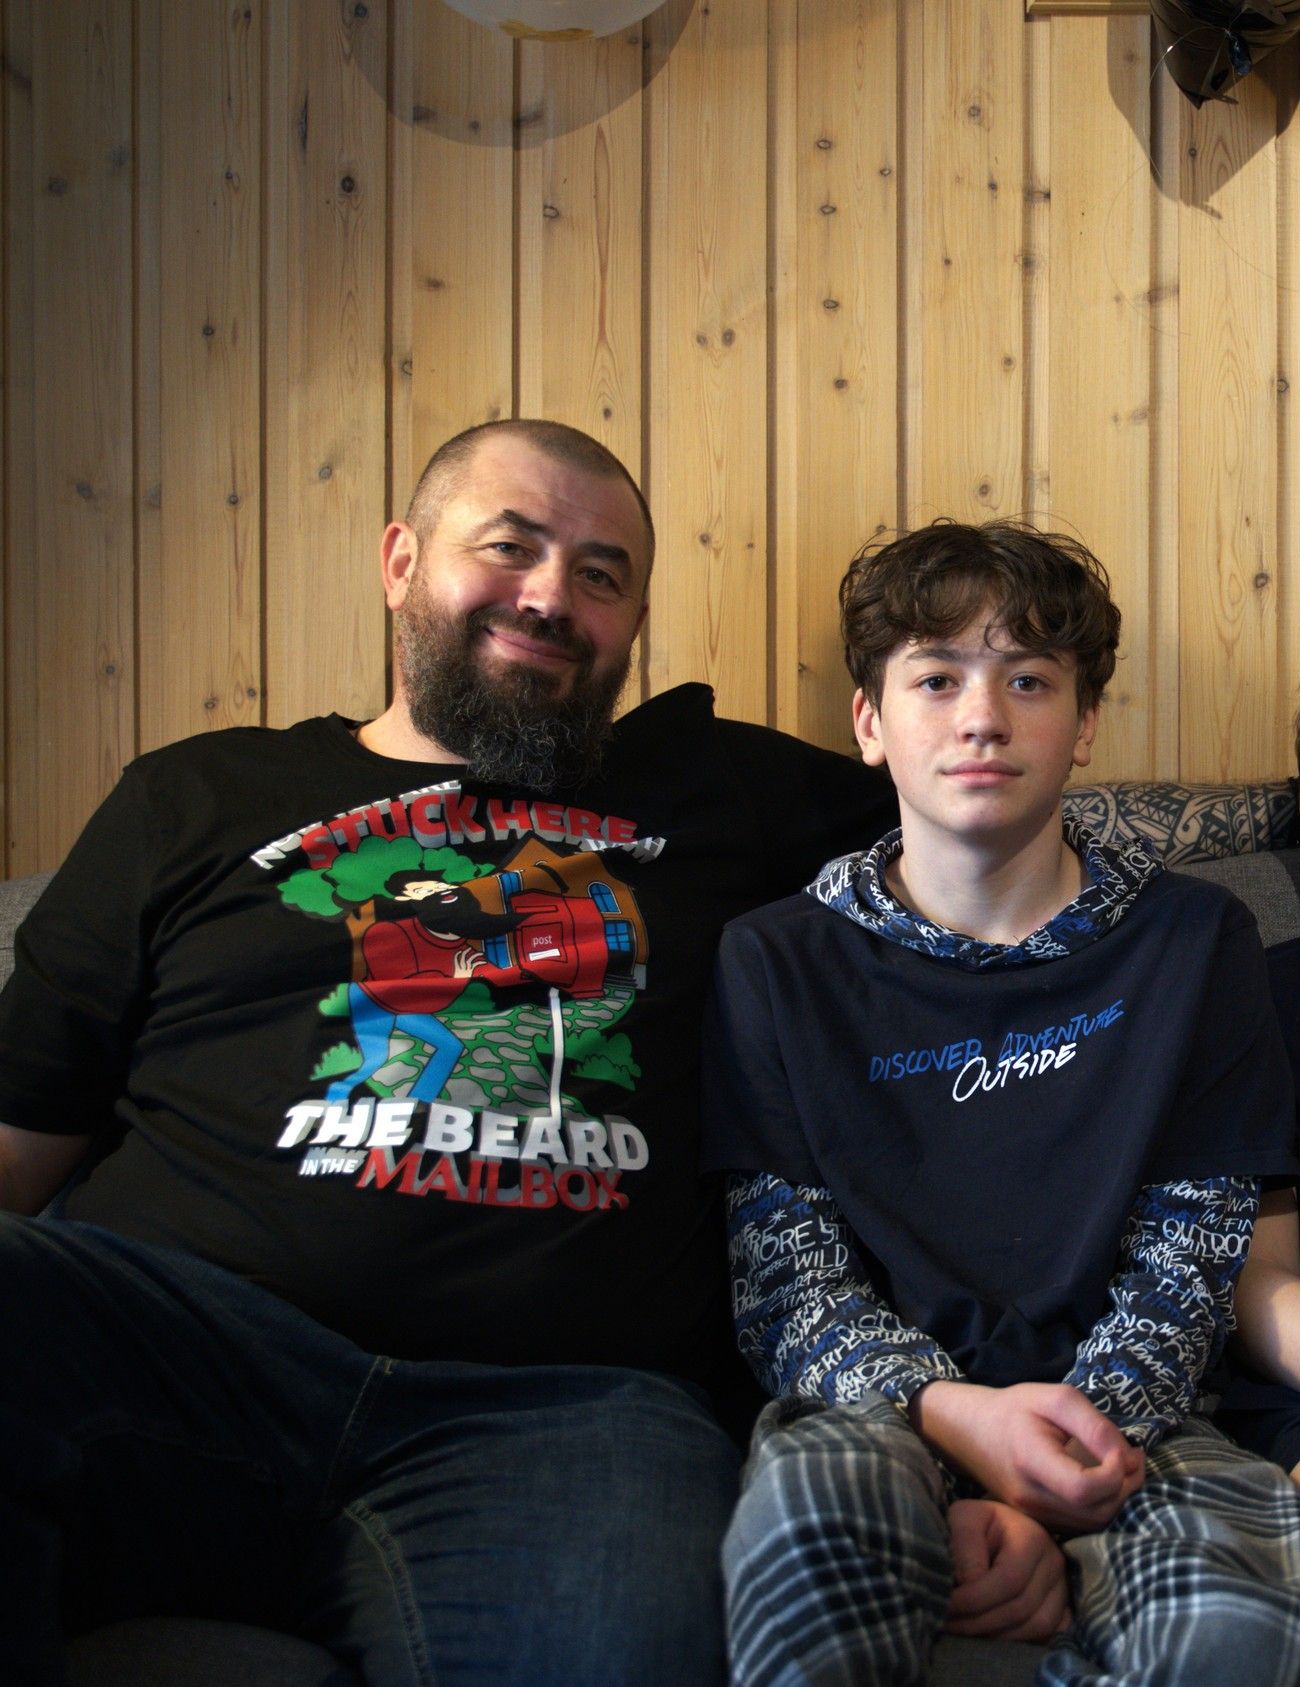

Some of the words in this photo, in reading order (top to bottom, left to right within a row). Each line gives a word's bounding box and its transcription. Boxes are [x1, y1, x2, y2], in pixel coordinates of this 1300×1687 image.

[301, 793, 486, 871] STUCK
[487, 798, 638, 845] HERE
[532, 935, 553, 948] post
[869, 1039, 983, 1082] DISCOVER
[997, 999, 1124, 1071] ADVENTURE
[952, 1043, 1077, 1102] OUTSIDE
[277, 1098, 418, 1148] THE
[423, 1102, 650, 1171] BEARD
[299, 1155, 319, 1176] IN
[320, 1155, 361, 1175] THE
[356, 1147, 630, 1212] MAILBOX
[793, 1243, 849, 1271] WILD
